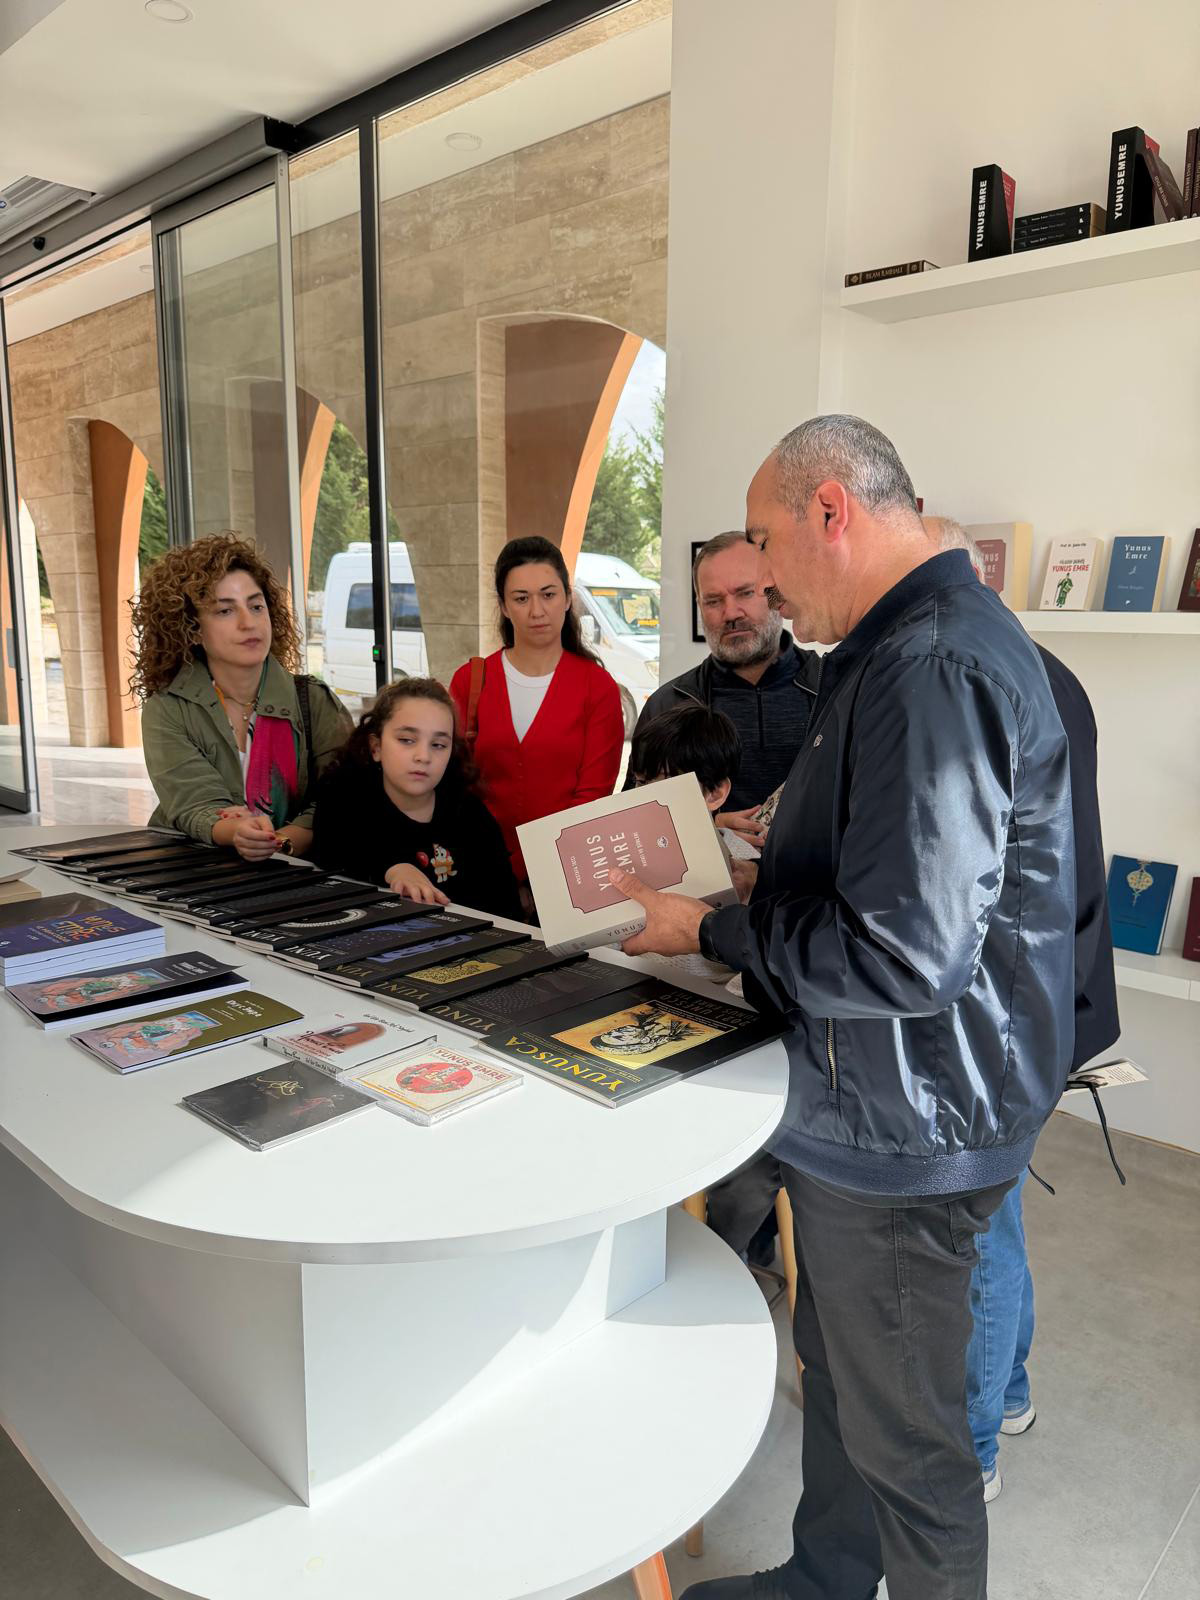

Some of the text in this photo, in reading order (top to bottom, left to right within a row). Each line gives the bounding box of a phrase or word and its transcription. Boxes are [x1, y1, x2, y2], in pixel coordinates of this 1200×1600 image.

[1114, 143, 1127, 221] YUNUSEMRE
[975, 179, 988, 250] YUNUSEMRE
[1124, 543, 1152, 553] Yunus
[1125, 552, 1148, 560] Emre
[428, 1004, 496, 1032] YUNU
[434, 1048, 507, 1081] YUNUS EMRE
[504, 1035, 624, 1092] YUNUSCA
